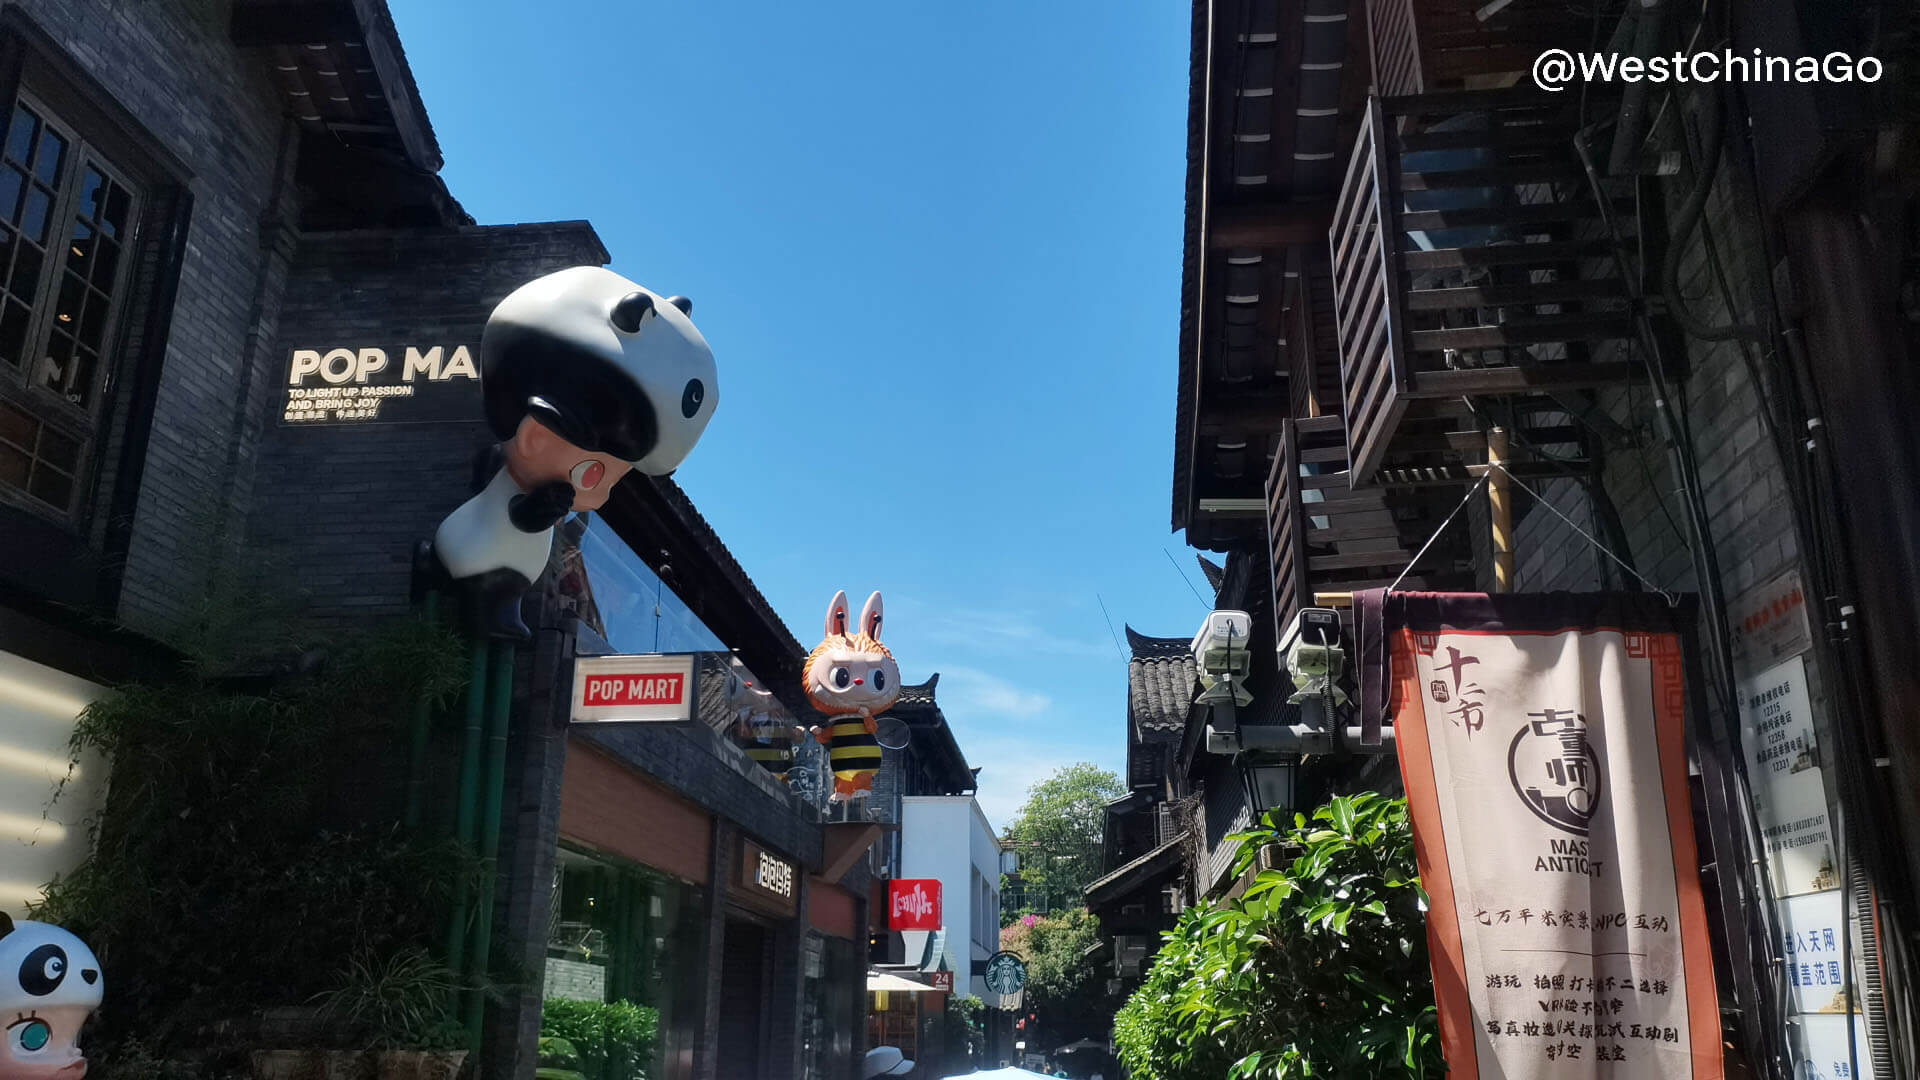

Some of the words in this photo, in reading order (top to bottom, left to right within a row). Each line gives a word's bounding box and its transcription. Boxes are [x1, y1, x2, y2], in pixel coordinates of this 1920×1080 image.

[289, 348, 388, 385] POP
[288, 389, 305, 399] TO
[307, 388, 341, 399] LIGHT
[342, 387, 360, 398] UP
[361, 385, 414, 397] PASSION
[286, 399, 313, 410] AND
[315, 398, 353, 409] BRING
[354, 398, 381, 409] JOY
[589, 680, 624, 701] POP
[628, 679, 679, 700] MART
[1763, 702, 1781, 717] 12315
[1772, 757, 1790, 773] 12331
[936, 974, 949, 985] 24
